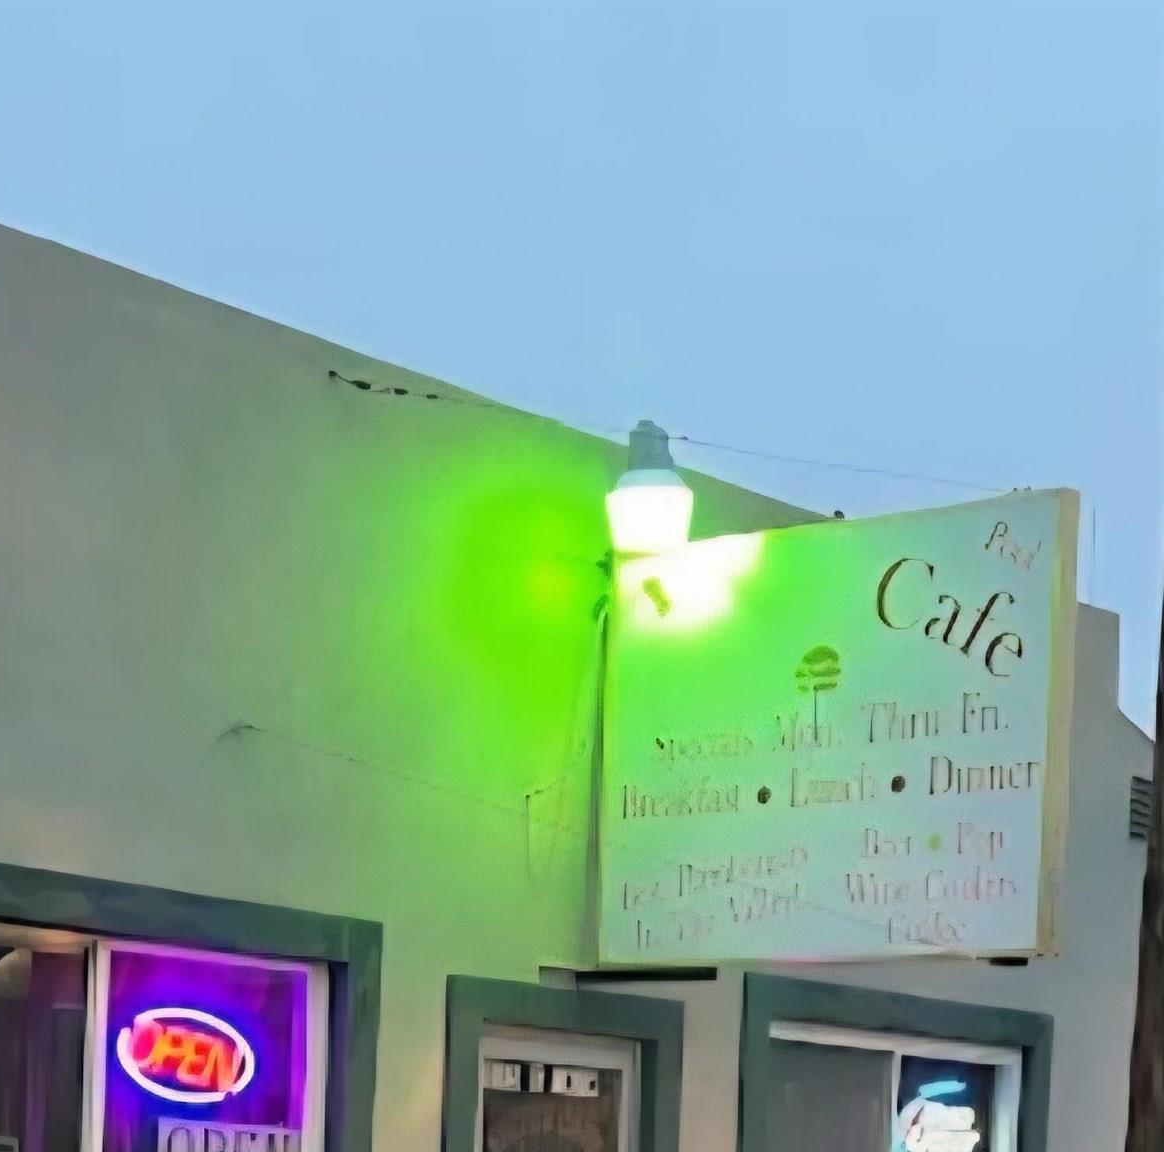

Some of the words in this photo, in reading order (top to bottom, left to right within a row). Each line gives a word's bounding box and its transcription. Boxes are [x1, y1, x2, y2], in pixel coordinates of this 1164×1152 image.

[877, 557, 1023, 678] Cafe
[929, 755, 1041, 795] Dinner
[133, 1020, 244, 1092] OPEN
